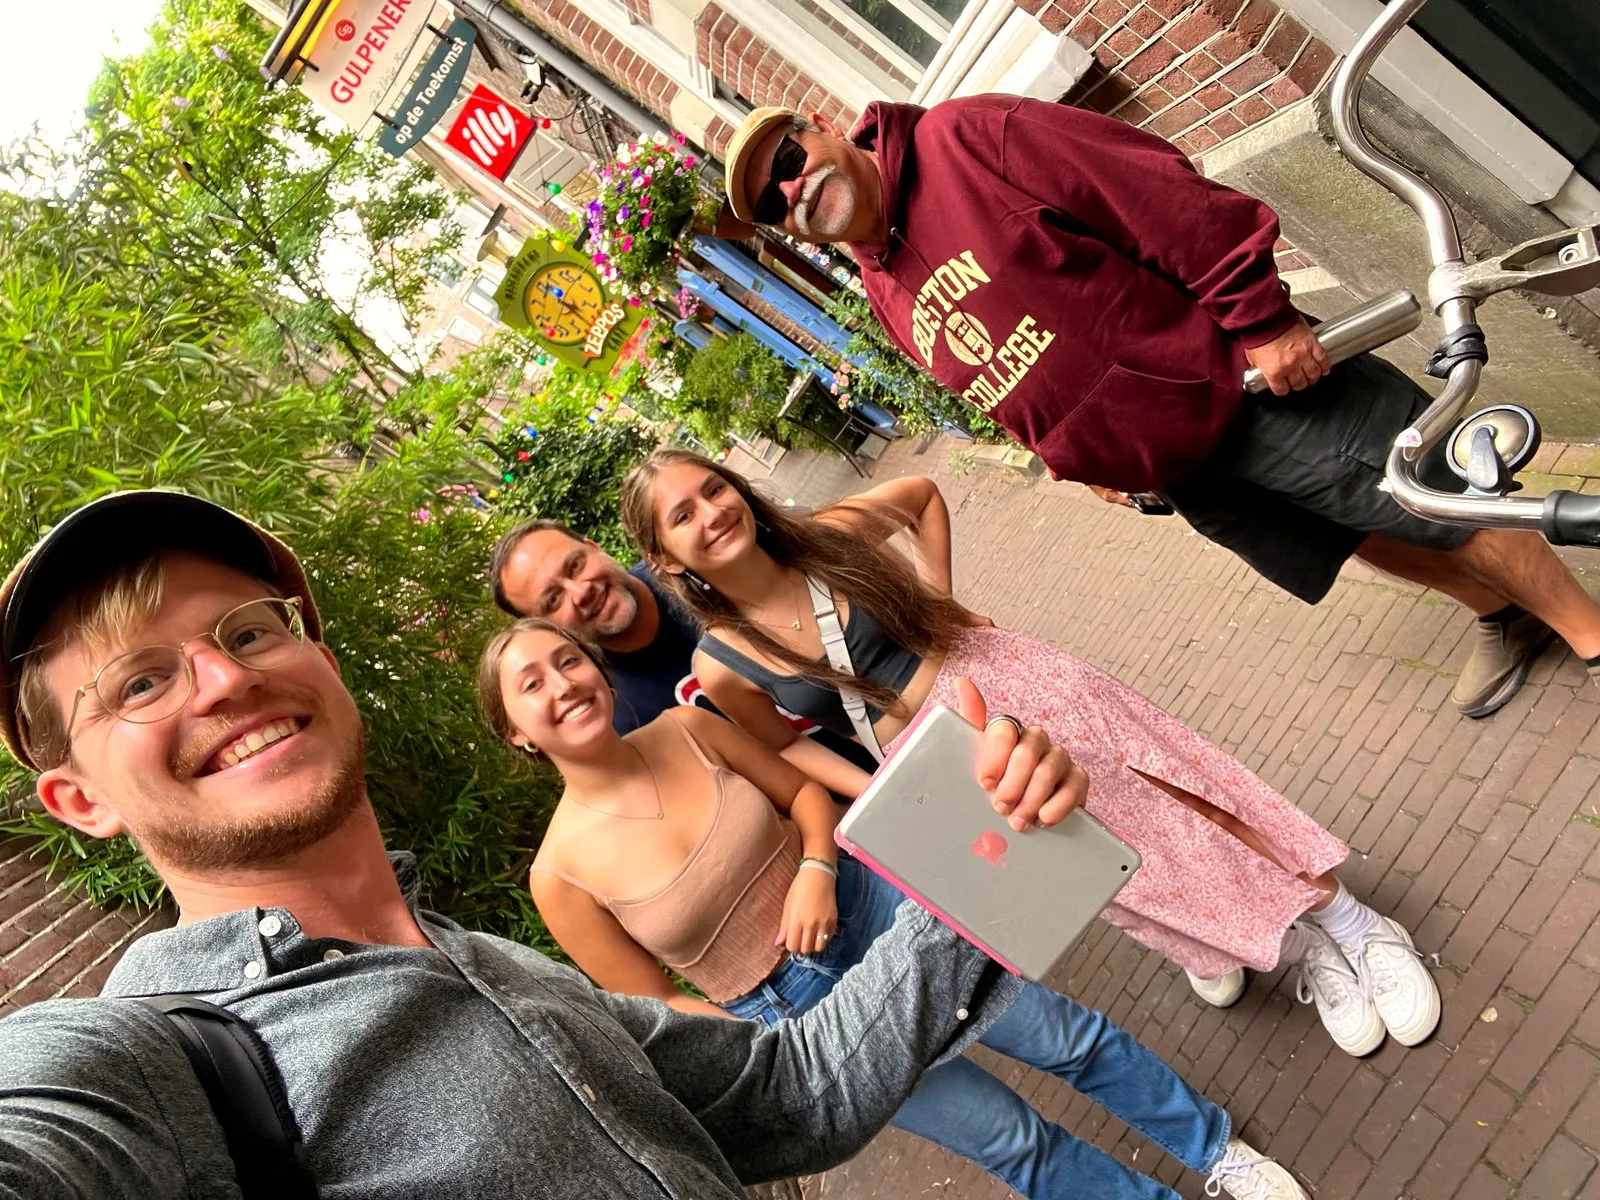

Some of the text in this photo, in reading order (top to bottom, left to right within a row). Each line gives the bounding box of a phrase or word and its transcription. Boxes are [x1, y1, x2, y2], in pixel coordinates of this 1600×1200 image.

[330, 0, 412, 104] GULPENER
[395, 37, 467, 145] op de Toekomst
[462, 104, 516, 166] illy
[584, 303, 625, 355] ZEPPOS
[912, 249, 991, 368] BOSTON
[961, 314, 1056, 412] COLLEGE
